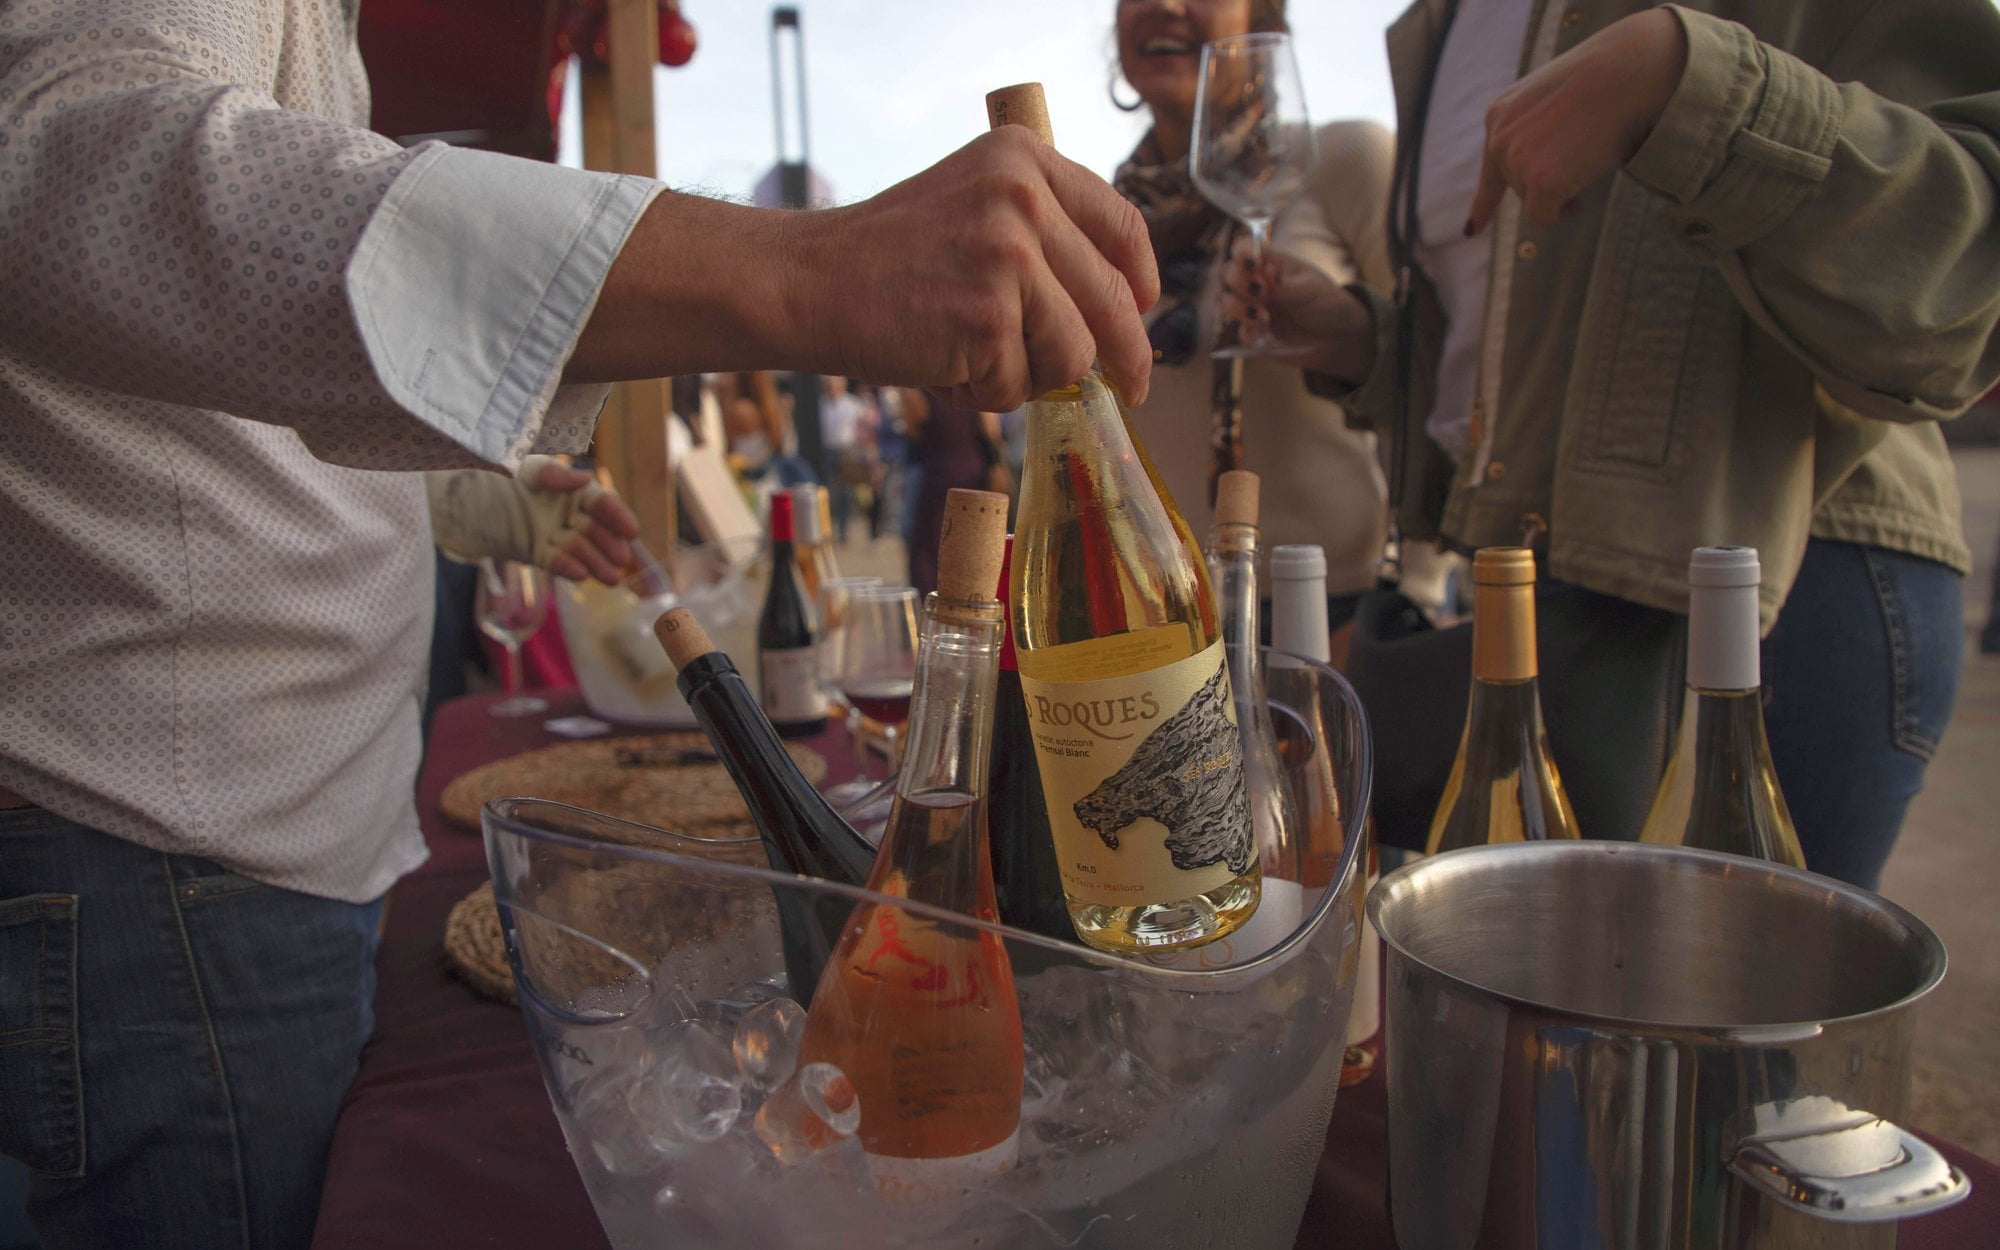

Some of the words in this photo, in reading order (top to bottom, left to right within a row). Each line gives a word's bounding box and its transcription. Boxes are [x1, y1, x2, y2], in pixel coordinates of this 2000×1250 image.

[1034, 691, 1160, 740] ROQUES
[1066, 748, 1090, 758] Blanc
[1076, 863, 1097, 874] Km.0
[1103, 883, 1145, 892] Mallorca
